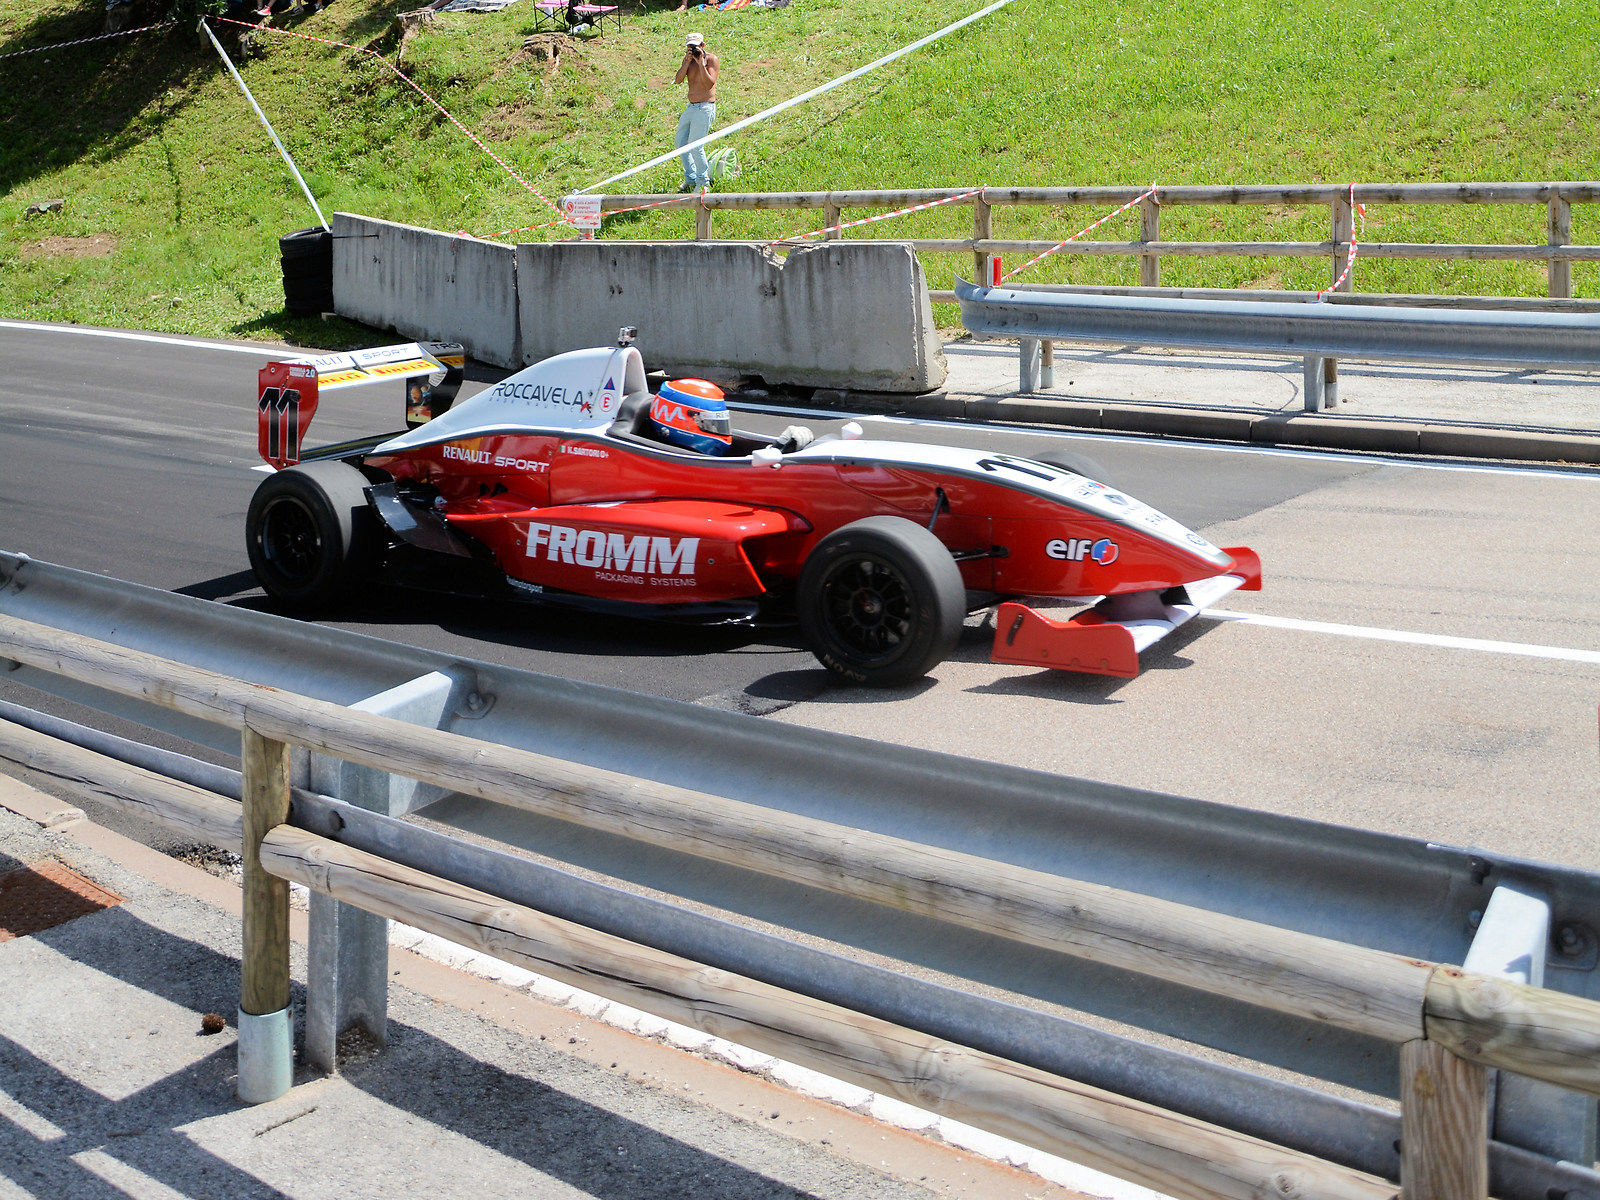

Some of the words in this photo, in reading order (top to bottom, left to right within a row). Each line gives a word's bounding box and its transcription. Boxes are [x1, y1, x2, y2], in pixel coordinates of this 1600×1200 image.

[362, 347, 408, 360] SPORT
[491, 382, 584, 407] ROCCAVELA
[259, 387, 300, 462] 11
[443, 445, 492, 465] RENAULT
[494, 456, 550, 473] SPORT
[525, 521, 701, 576] FROMM
[1045, 538, 1092, 561] elf
[595, 571, 645, 586] PACKAGING
[651, 577, 697, 587] SYSTEMS
